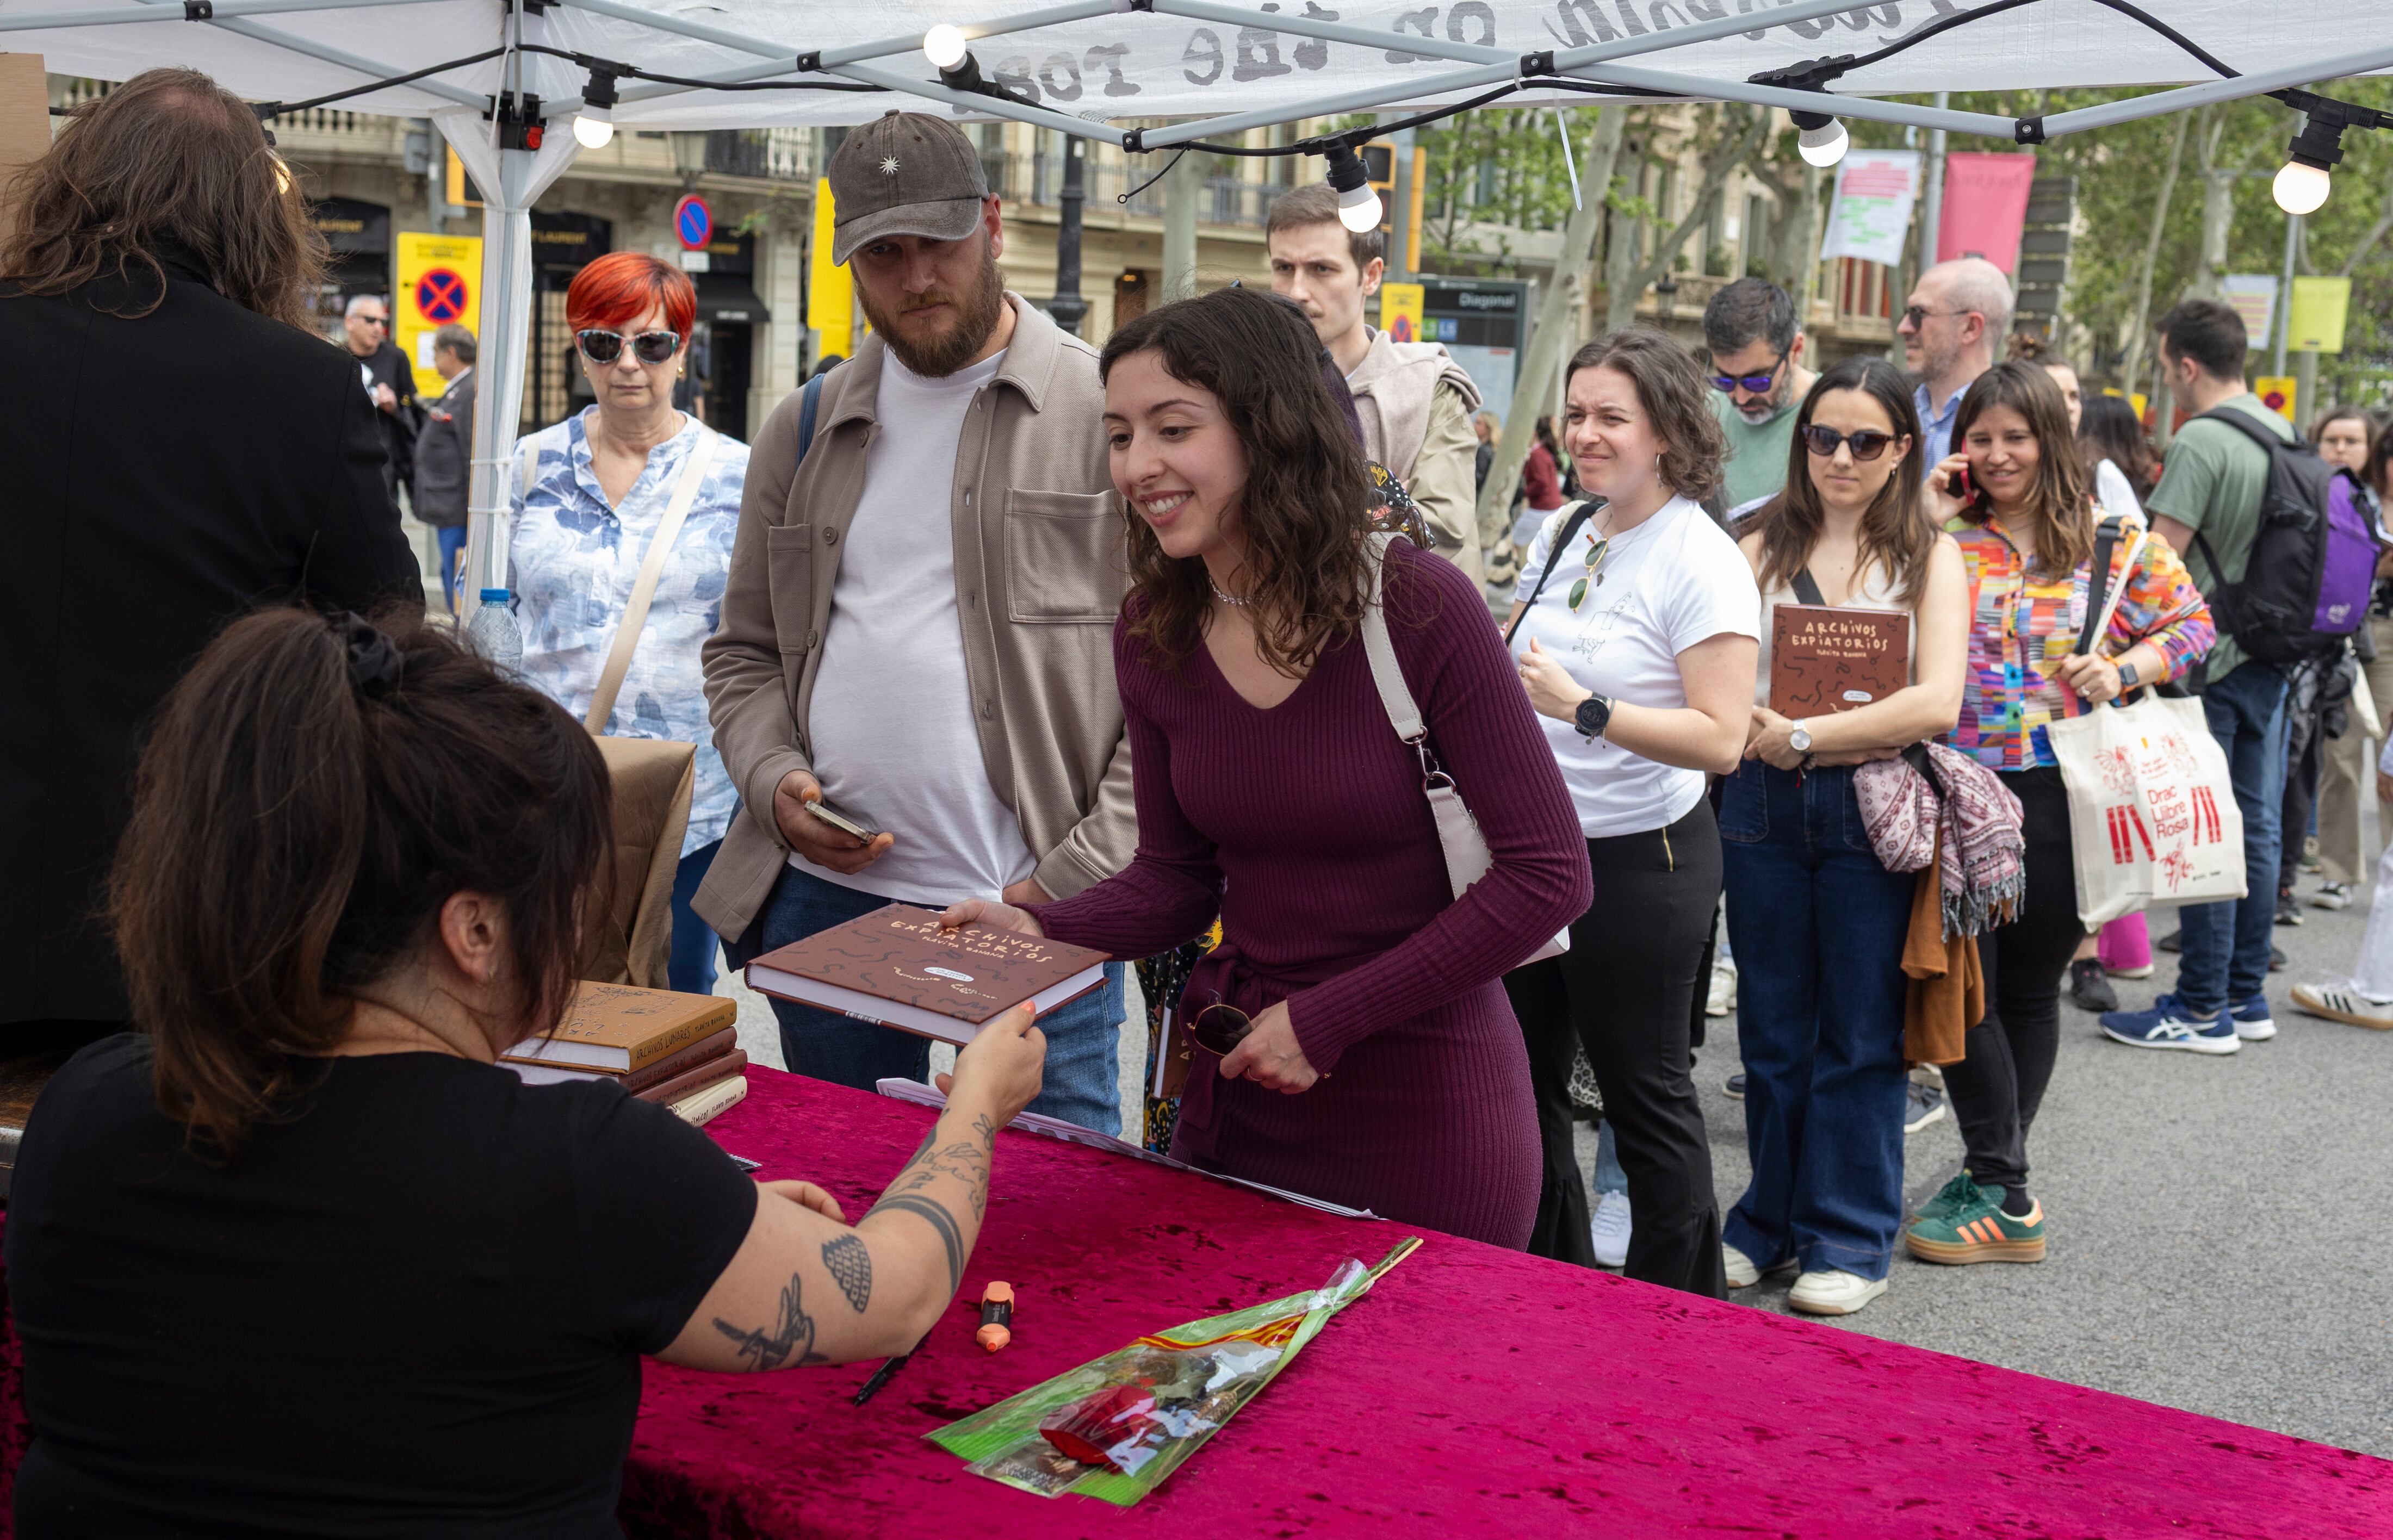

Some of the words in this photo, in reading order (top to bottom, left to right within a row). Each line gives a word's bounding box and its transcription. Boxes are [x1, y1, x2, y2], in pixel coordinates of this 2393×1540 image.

[1459, 292, 1516, 309] Diagonal
[2147, 786, 2177, 804] Drac
[2151, 801, 2186, 822] Llibre
[2157, 818, 2189, 840] Rosa
[966, 947, 1004, 959] BANANA
[665, 1026, 691, 1048] LUNARES
